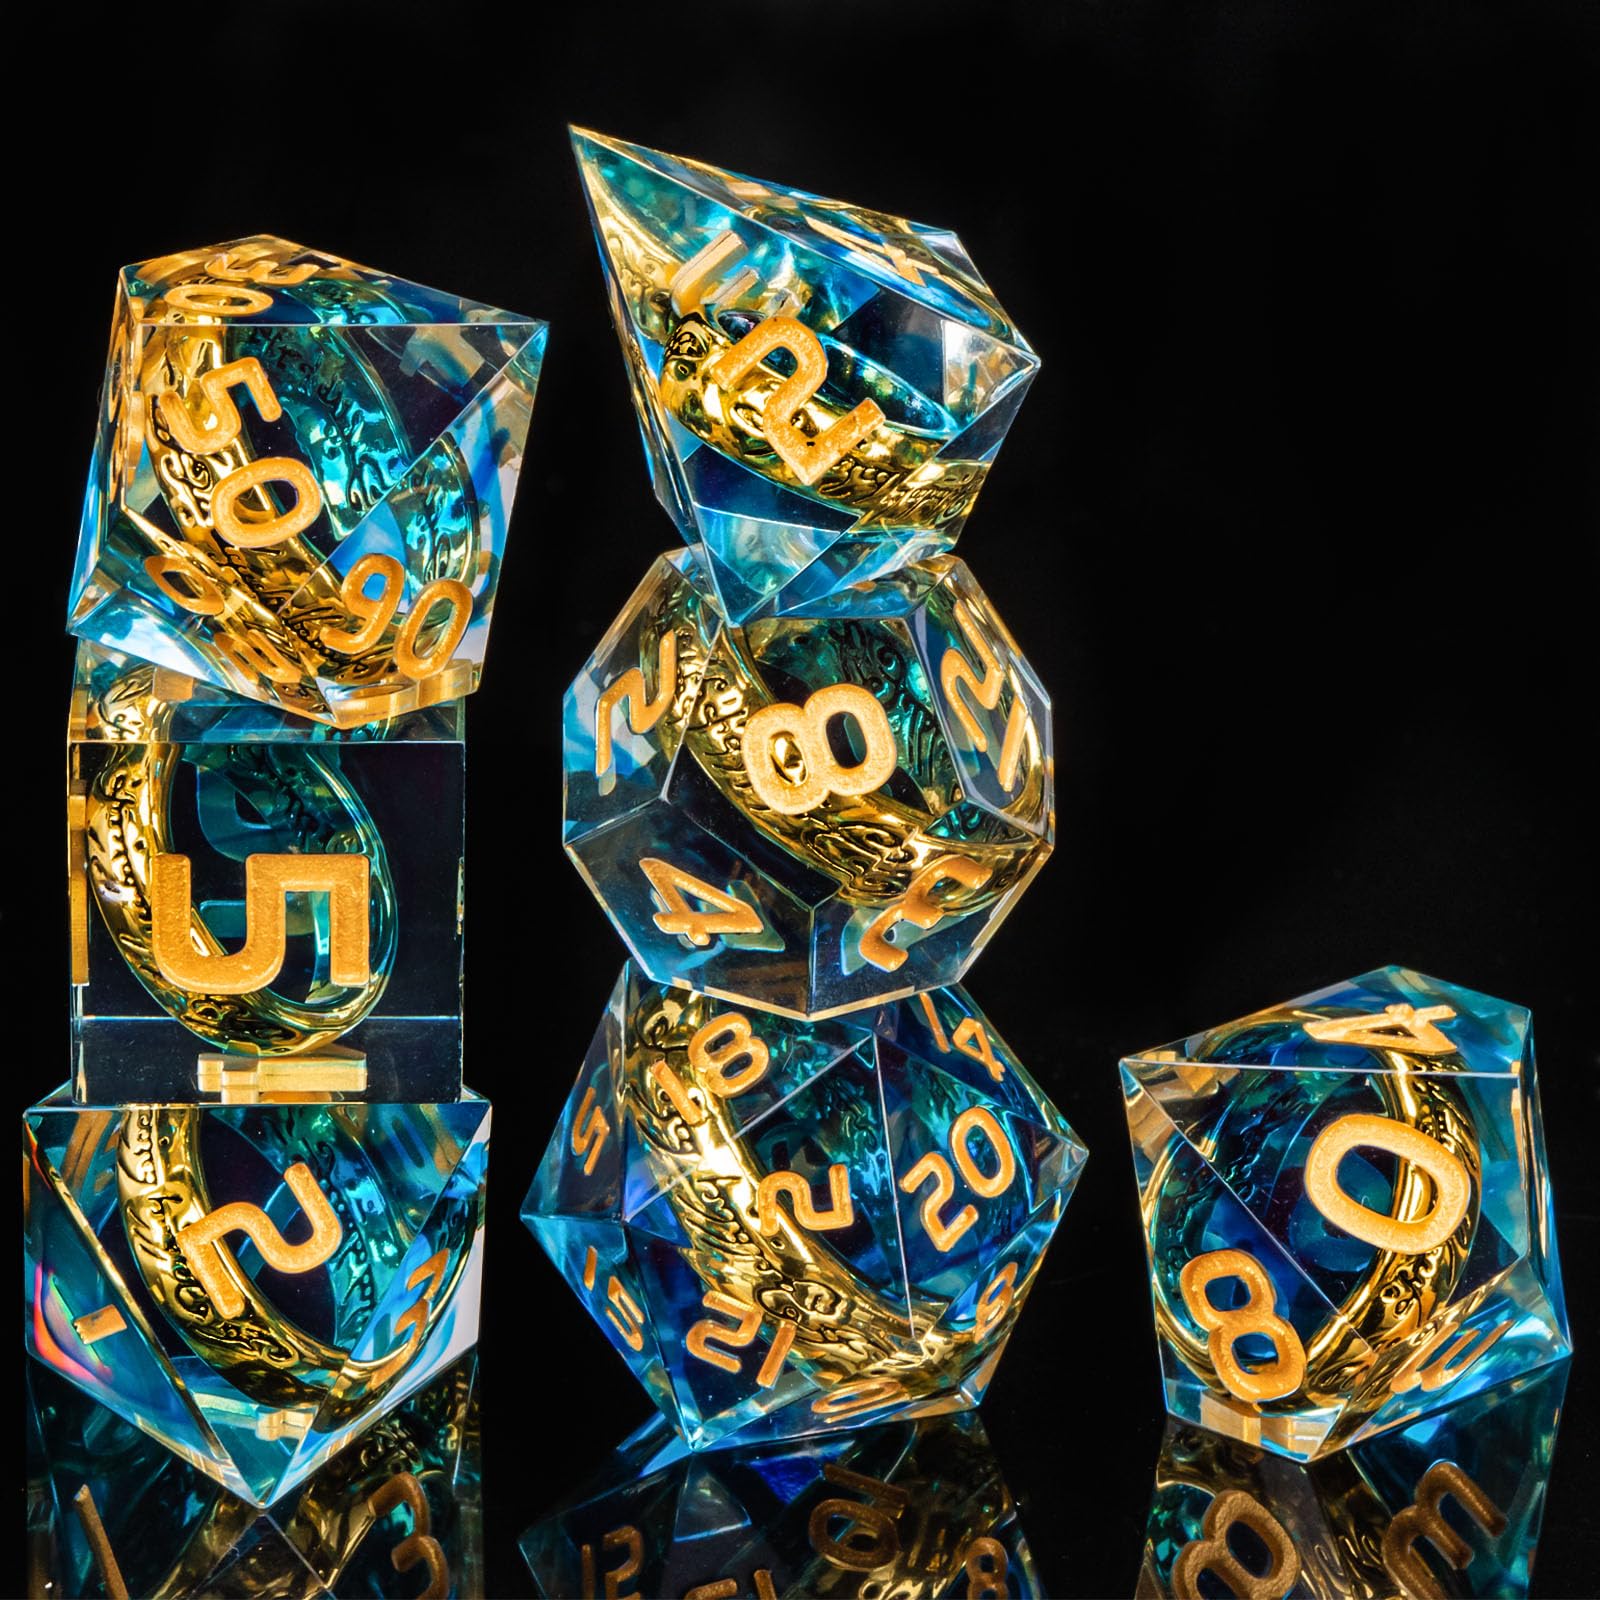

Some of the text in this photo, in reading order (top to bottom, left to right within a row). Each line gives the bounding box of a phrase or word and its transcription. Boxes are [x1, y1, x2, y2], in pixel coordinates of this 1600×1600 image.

[158, 357, 322, 547] 50
[711, 316, 886, 485] 2
[319, 553, 473, 679] 90
[744, 683, 897, 815] 8
[152, 853, 370, 995] 5
[639, 857, 764, 946] 4
[655, 1011, 770, 1127] 18
[1304, 1003, 1458, 1055] 4
[177, 1162, 343, 1320] 2
[757, 1164, 856, 1237] 2
[903, 1106, 1016, 1253] 20
[1304, 1114, 1471, 1256] 0
[1180, 1248, 1306, 1401] 8
